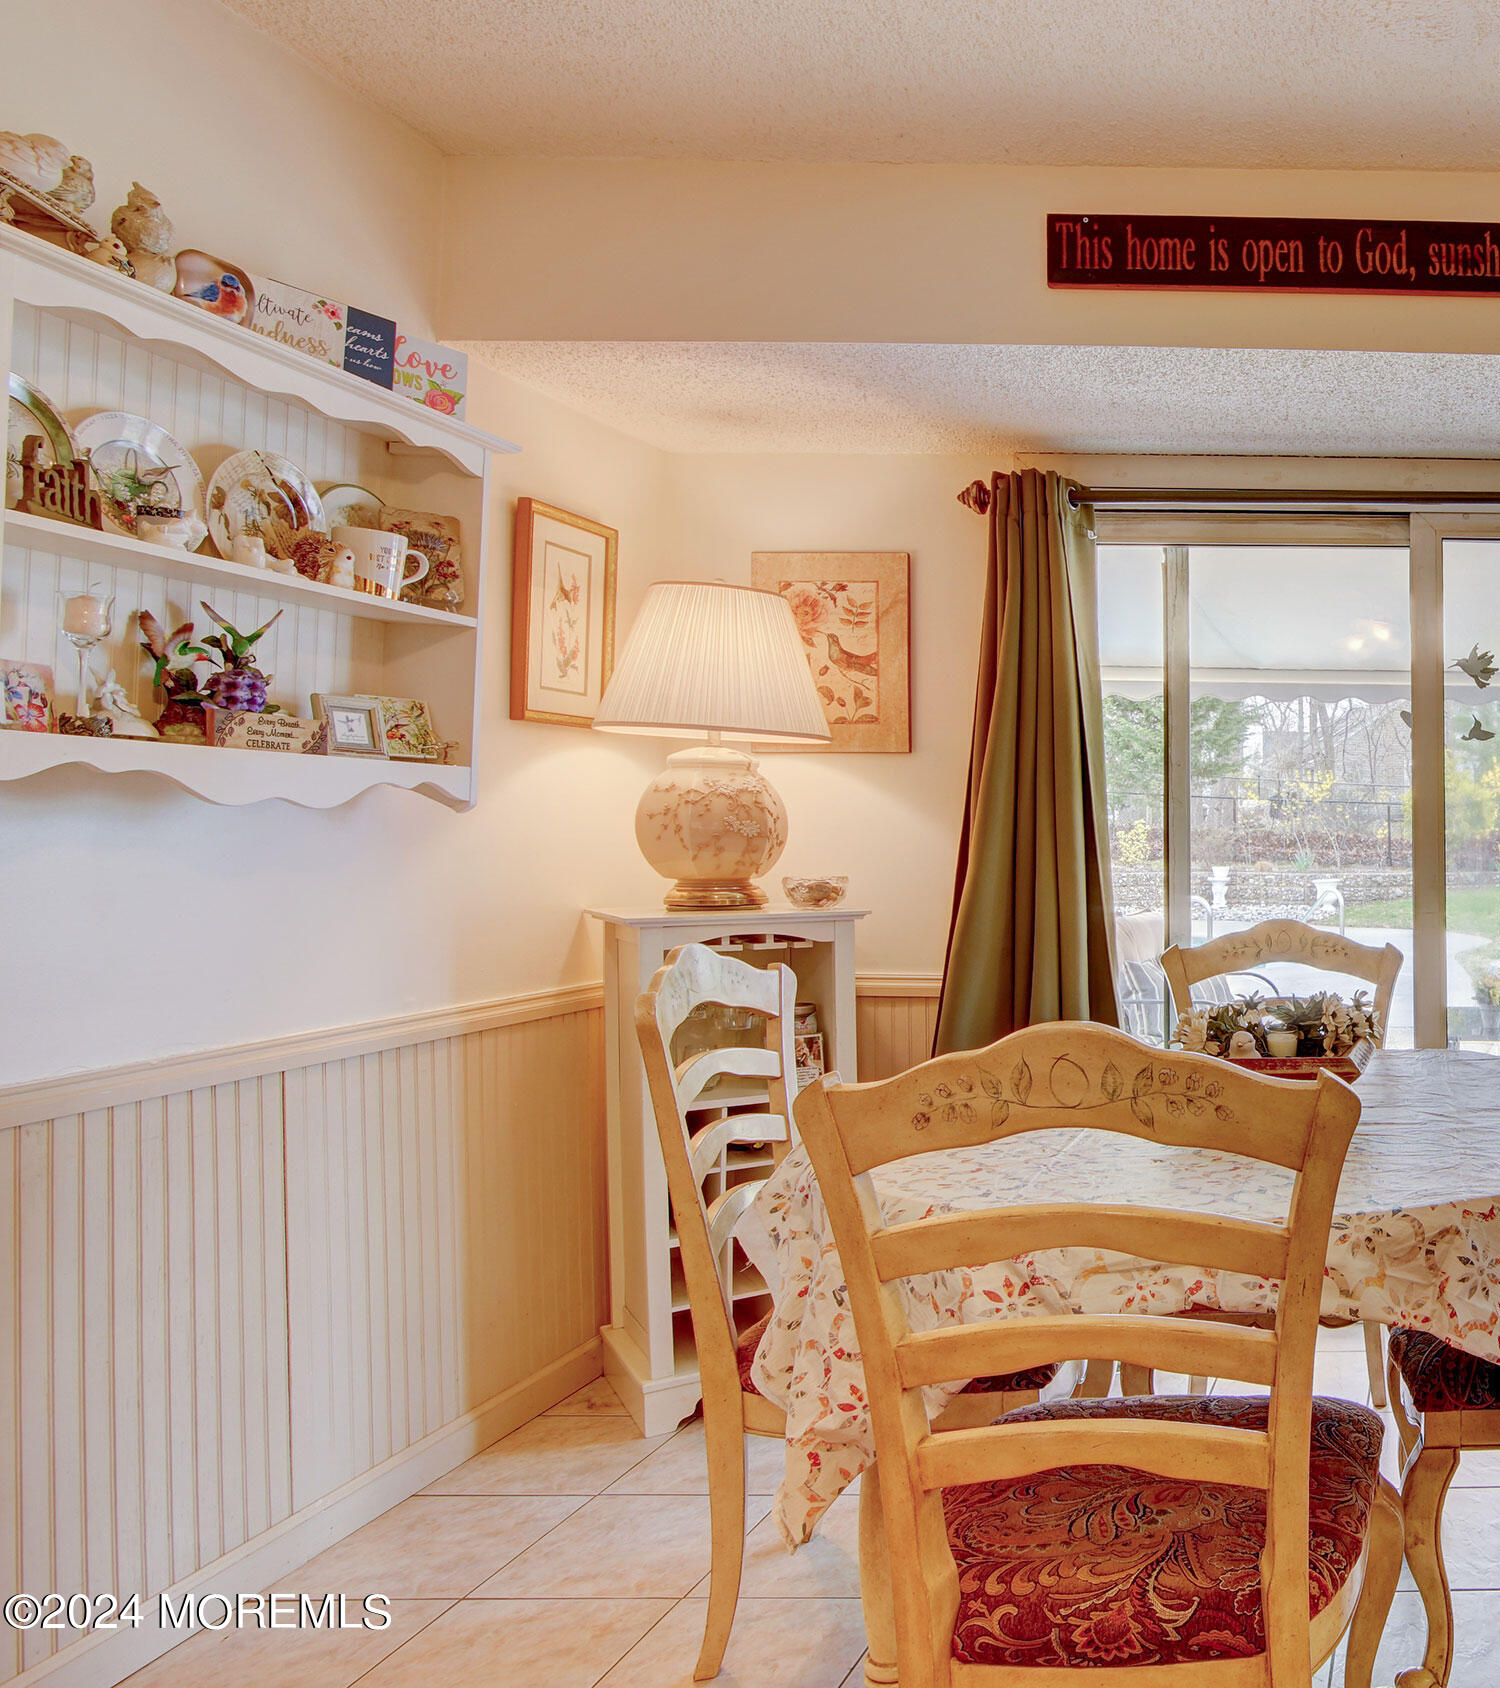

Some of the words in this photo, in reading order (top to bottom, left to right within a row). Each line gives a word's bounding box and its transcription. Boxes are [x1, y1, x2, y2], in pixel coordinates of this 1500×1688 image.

[1056, 222, 1113, 269] This
[1126, 224, 1196, 271] home
[1209, 225, 1229, 271] is
[1242, 239, 1305, 282] open
[1318, 235, 1343, 273] to
[1355, 227, 1416, 282] God,
[254, 293, 313, 326] ltivate
[252, 320, 329, 356] ndness
[346, 325, 384, 342] eams
[345, 336, 389, 360] hearts
[394, 335, 458, 380] Love
[393, 368, 423, 390] OWS
[22, 435, 103, 530] faith
[246, 726, 265, 738] Every
[246, 738, 291, 750] CELEBRATE
